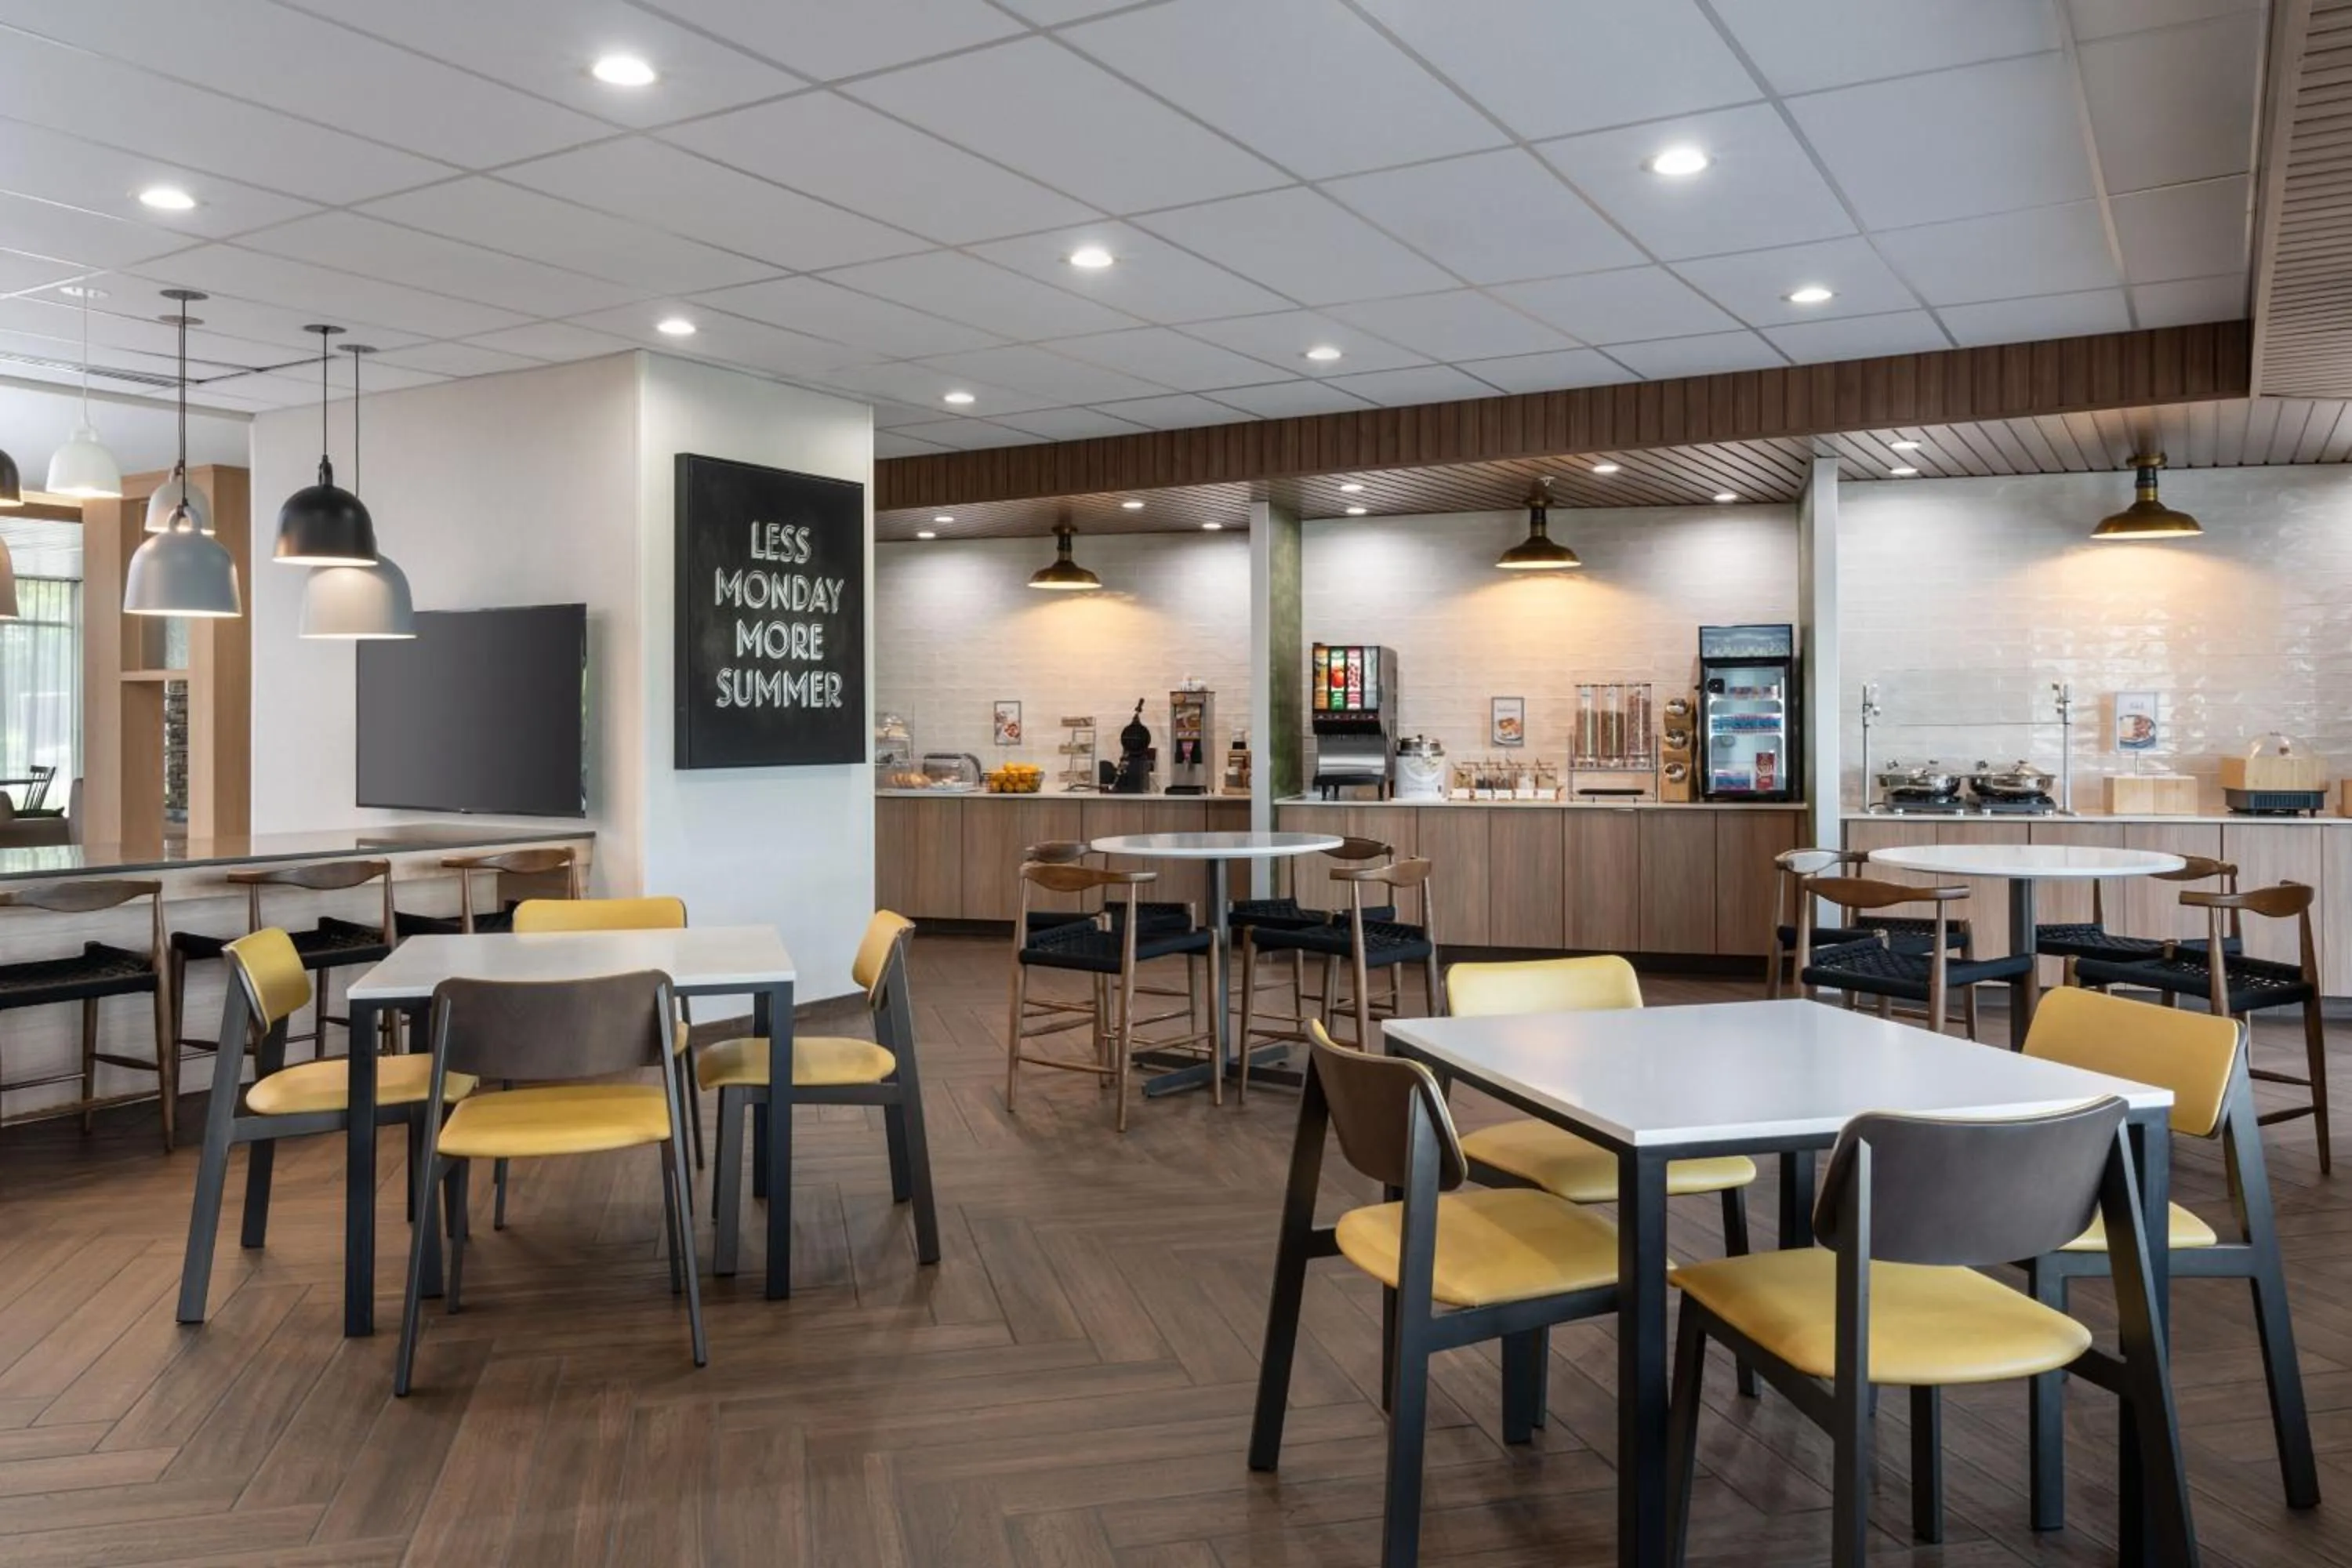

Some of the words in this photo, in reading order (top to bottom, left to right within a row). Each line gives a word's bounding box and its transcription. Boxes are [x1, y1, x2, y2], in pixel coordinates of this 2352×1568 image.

[750, 520, 812, 564] LESS
[714, 566, 844, 614] MONDAY
[735, 619, 824, 660] MORE
[715, 667, 844, 709] SUMMER
